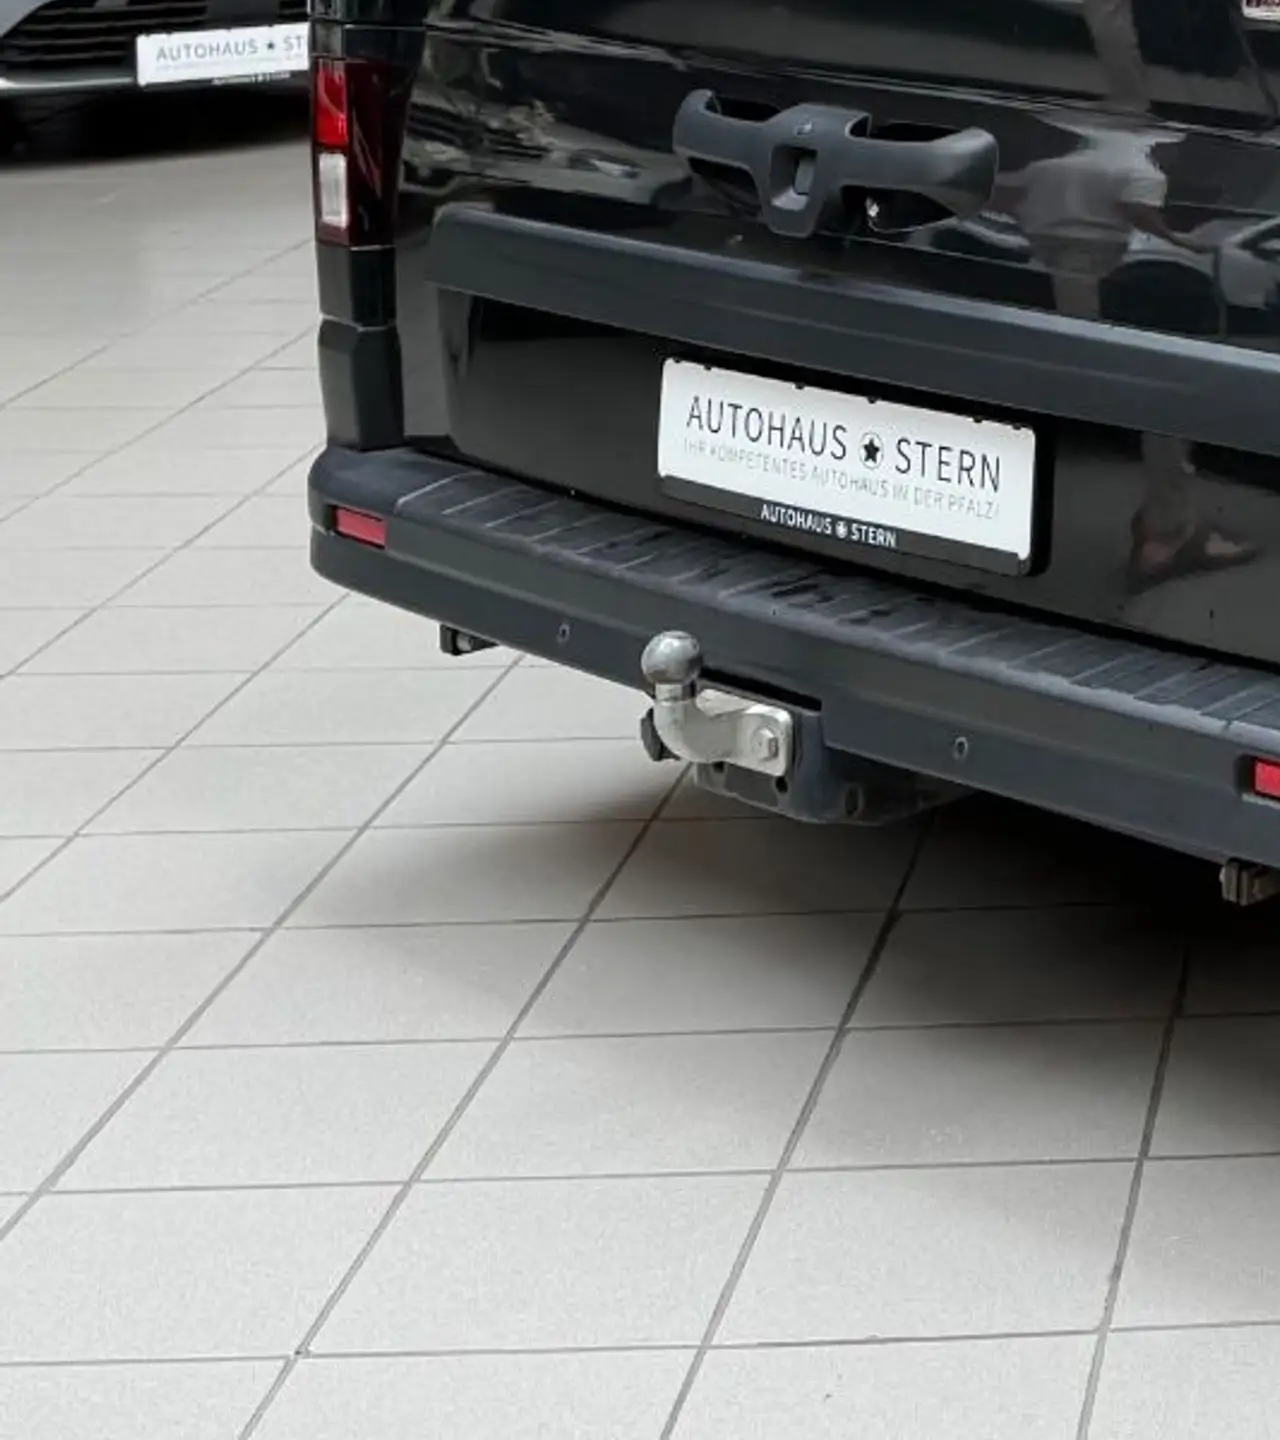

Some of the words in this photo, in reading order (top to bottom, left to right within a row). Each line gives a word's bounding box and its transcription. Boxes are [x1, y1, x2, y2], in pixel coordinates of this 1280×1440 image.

[156, 38, 258, 62] AUTOHAUS
[686, 394, 849, 461] AUTOHAUS
[894, 436, 1001, 493] STERN
[811, 464, 889, 499] AUTOHAUS
[914, 485, 944, 513] DER
[760, 503, 833, 536] AUTOHAUS
[849, 525, 897, 549] STERN
